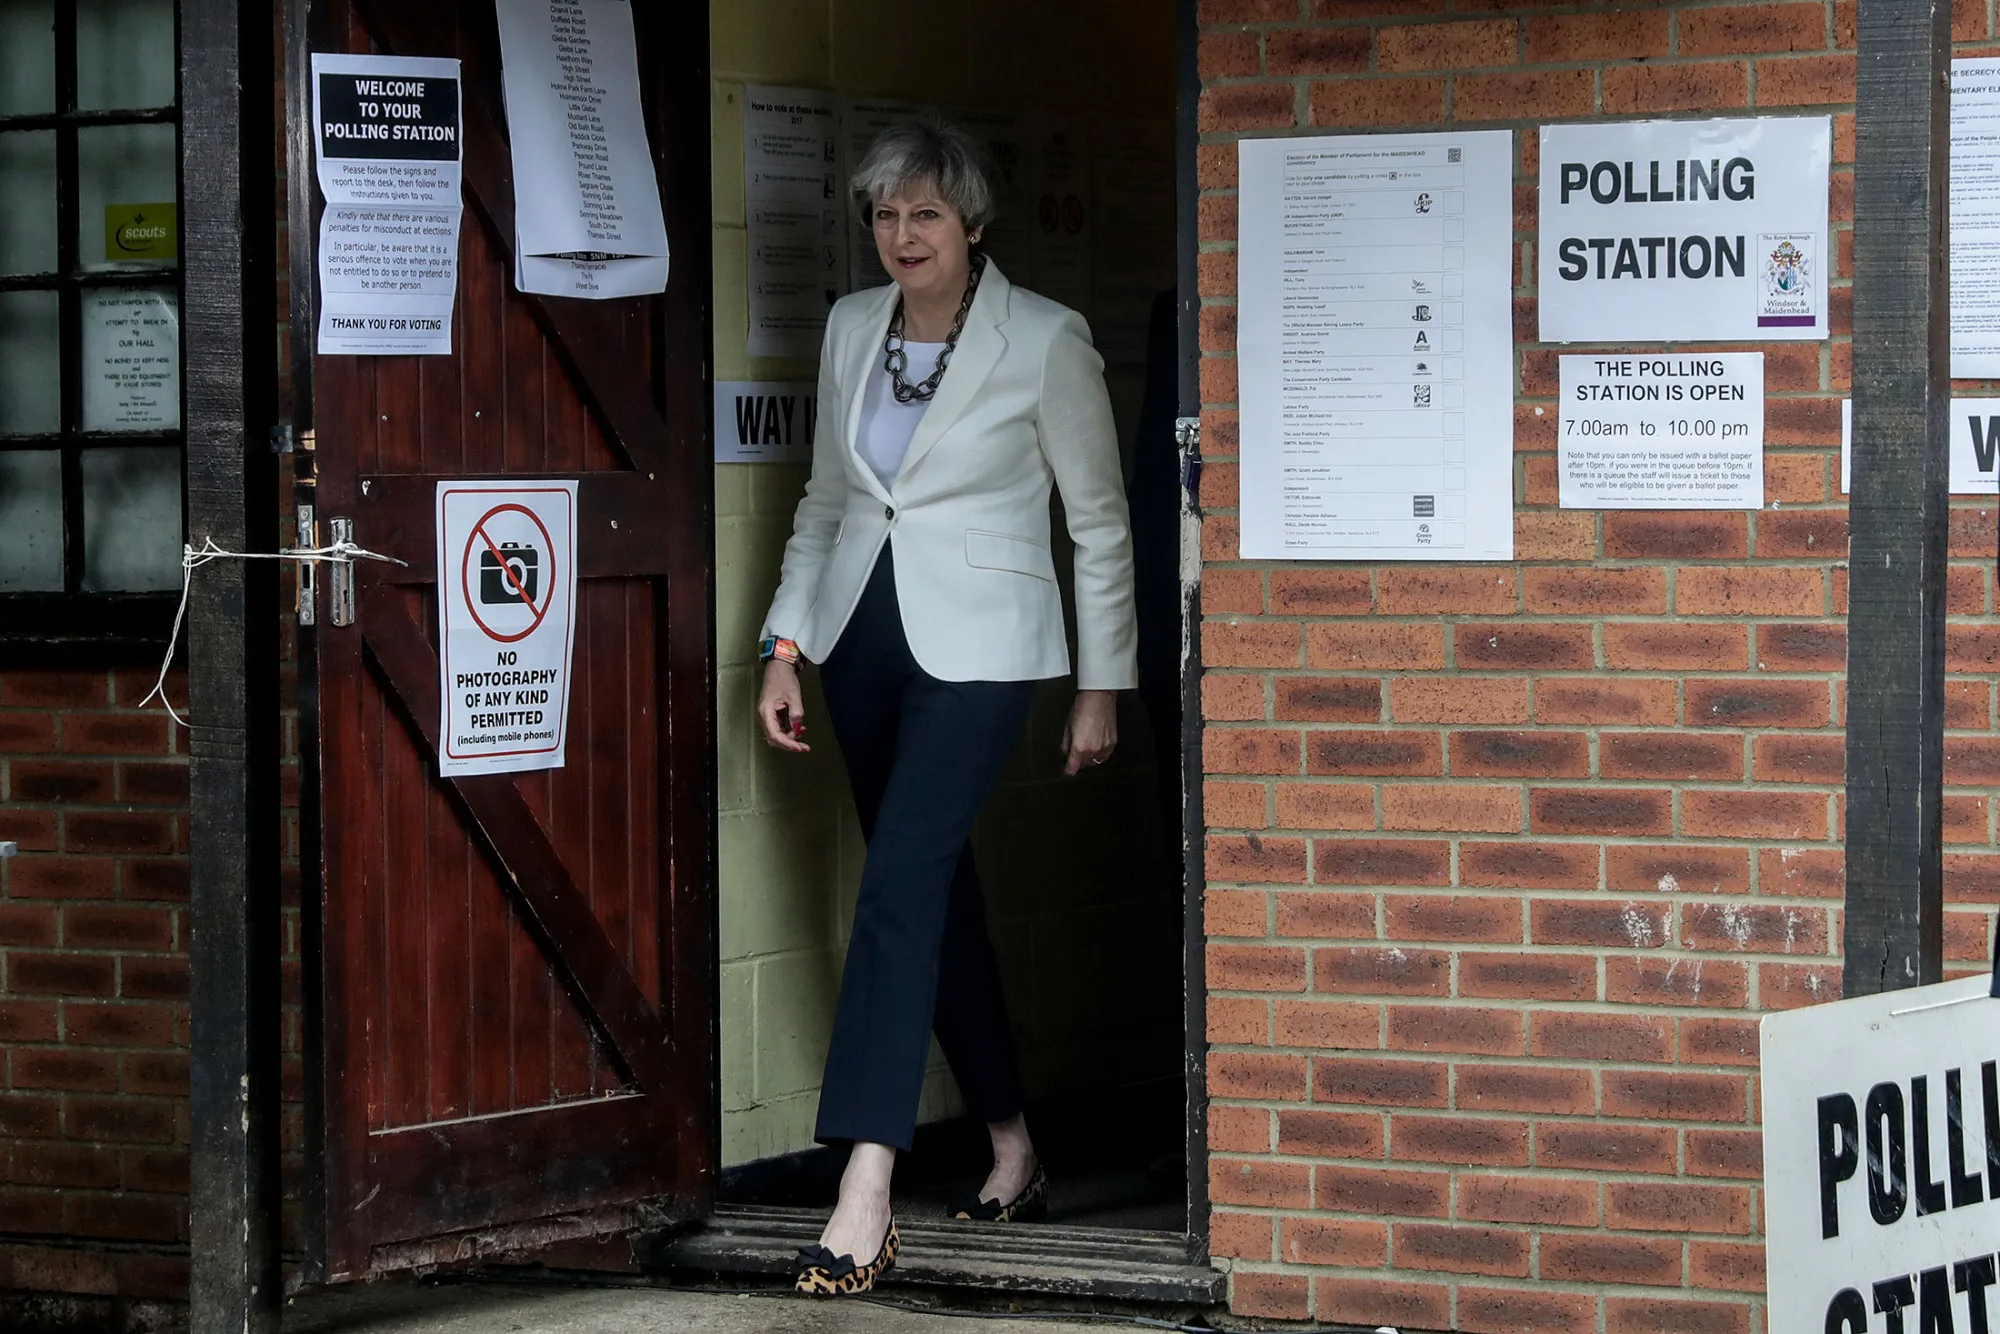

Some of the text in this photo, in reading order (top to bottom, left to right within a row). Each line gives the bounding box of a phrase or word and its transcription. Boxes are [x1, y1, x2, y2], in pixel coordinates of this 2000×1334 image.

[355, 80, 425, 97] WELCOME
[359, 102, 421, 118] TO YOUR
[752, 101, 765, 111] How
[767, 103, 772, 111] to
[774, 104, 787, 112] vote
[789, 105, 794, 113] at
[325, 123, 454, 141] POLLING STATION
[343, 165, 436, 177] Please follow the signs and
[332, 178, 353, 187] report
[364, 178, 376, 186] the
[378, 178, 396, 188] desk,
[398, 179, 413, 187] then
[416, 180, 435, 188] follow
[1560, 157, 1754, 204] POLLING
[350, 190, 389, 199] instructions
[391, 191, 409, 200] given
[337, 212, 358, 220] Kindly
[377, 212, 390, 221] that
[393, 213, 410, 222] there
[425, 215, 448, 223] various
[125, 226, 166, 238] scouts
[329, 224, 359, 233] penalties
[362, 224, 371, 233] for
[374, 225, 411, 234] misconduct
[334, 242, 341, 250] In
[344, 242, 379, 253] particular,
[381, 243, 390, 252] be
[414, 245, 428, 253] that
[430, 245, 434, 253] it
[436, 245, 441, 253] is
[1559, 235, 1745, 281] STATION
[332, 318, 365, 329] THANK
[368, 319, 386, 329] YOU
[389, 319, 406, 330] FOR
[1595, 360, 1724, 377] THE POLLING
[1577, 385, 1744, 401] STATION IS OPEN
[736, 396, 796, 444] WAY
[1565, 420, 1748, 439] 7.00am to 10.00 pm
[1632, 452, 1647, 460] only
[497, 652, 517, 666] NO
[456, 669, 558, 688] PHOTOGRAPHY
[465, 689, 548, 708] OF ANY KIND
[471, 710, 543, 728] PERMITTED
[457, 729, 554, 746] (including mobile phones)
[1816, 1060, 2000, 1240] POLLI
